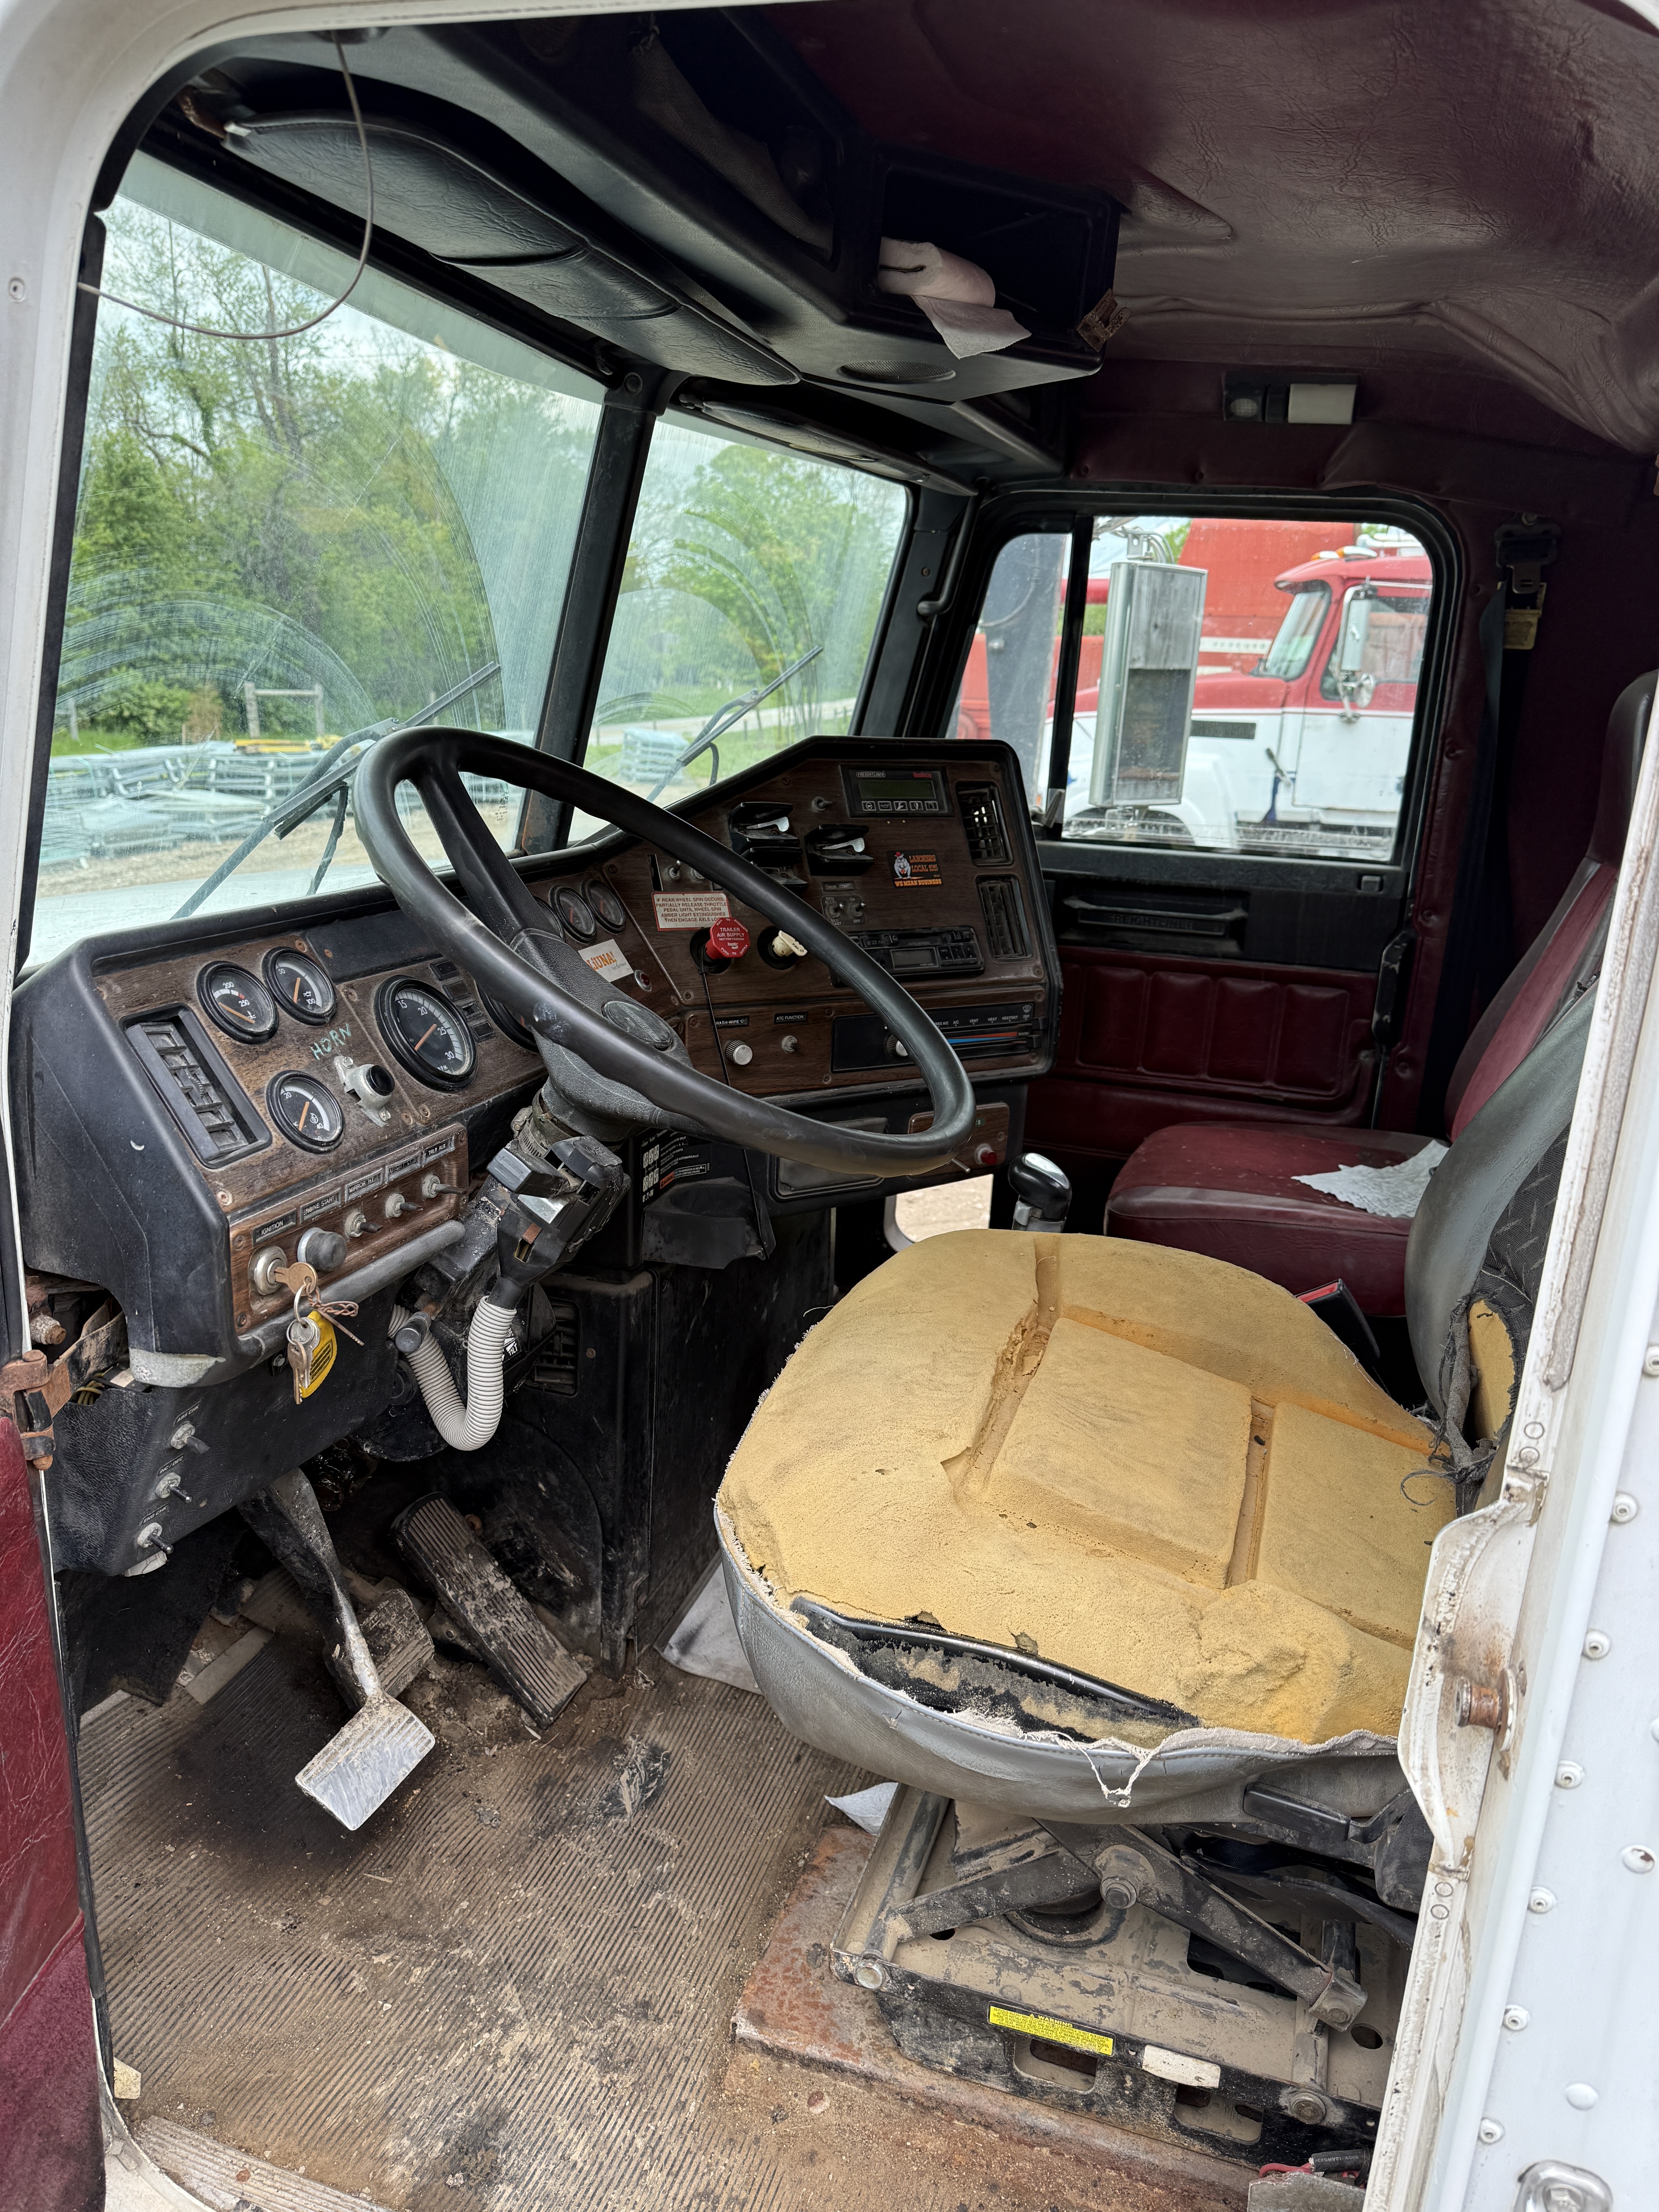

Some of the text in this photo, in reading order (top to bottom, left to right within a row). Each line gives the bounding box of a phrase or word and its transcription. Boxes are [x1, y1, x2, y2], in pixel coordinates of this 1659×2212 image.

[909, 855, 936, 863] LABORERS
[734, 919, 748, 932] EVACUATE
[398, 1000, 407, 1009] 15
[418, 1006, 428, 1016] 20
[438, 1027, 447, 1036] 25
[310, 1022, 352, 1060] HORN
[445, 1051, 455, 1060] 30
[349, 1182, 366, 1193] MIRROR
[303, 1196, 335, 1215] ENGINE START
[261, 1220, 283, 1235] IGNITION
[508, 1343, 518, 1356] TILT
[177, 1404, 199, 1422] ABS CHK
[159, 1466, 169, 1474] INC
[172, 1456, 184, 1466] DEC
[143, 1506, 167, 1523] ENG CHK
[1038, 2015, 1073, 2028] WARNING
